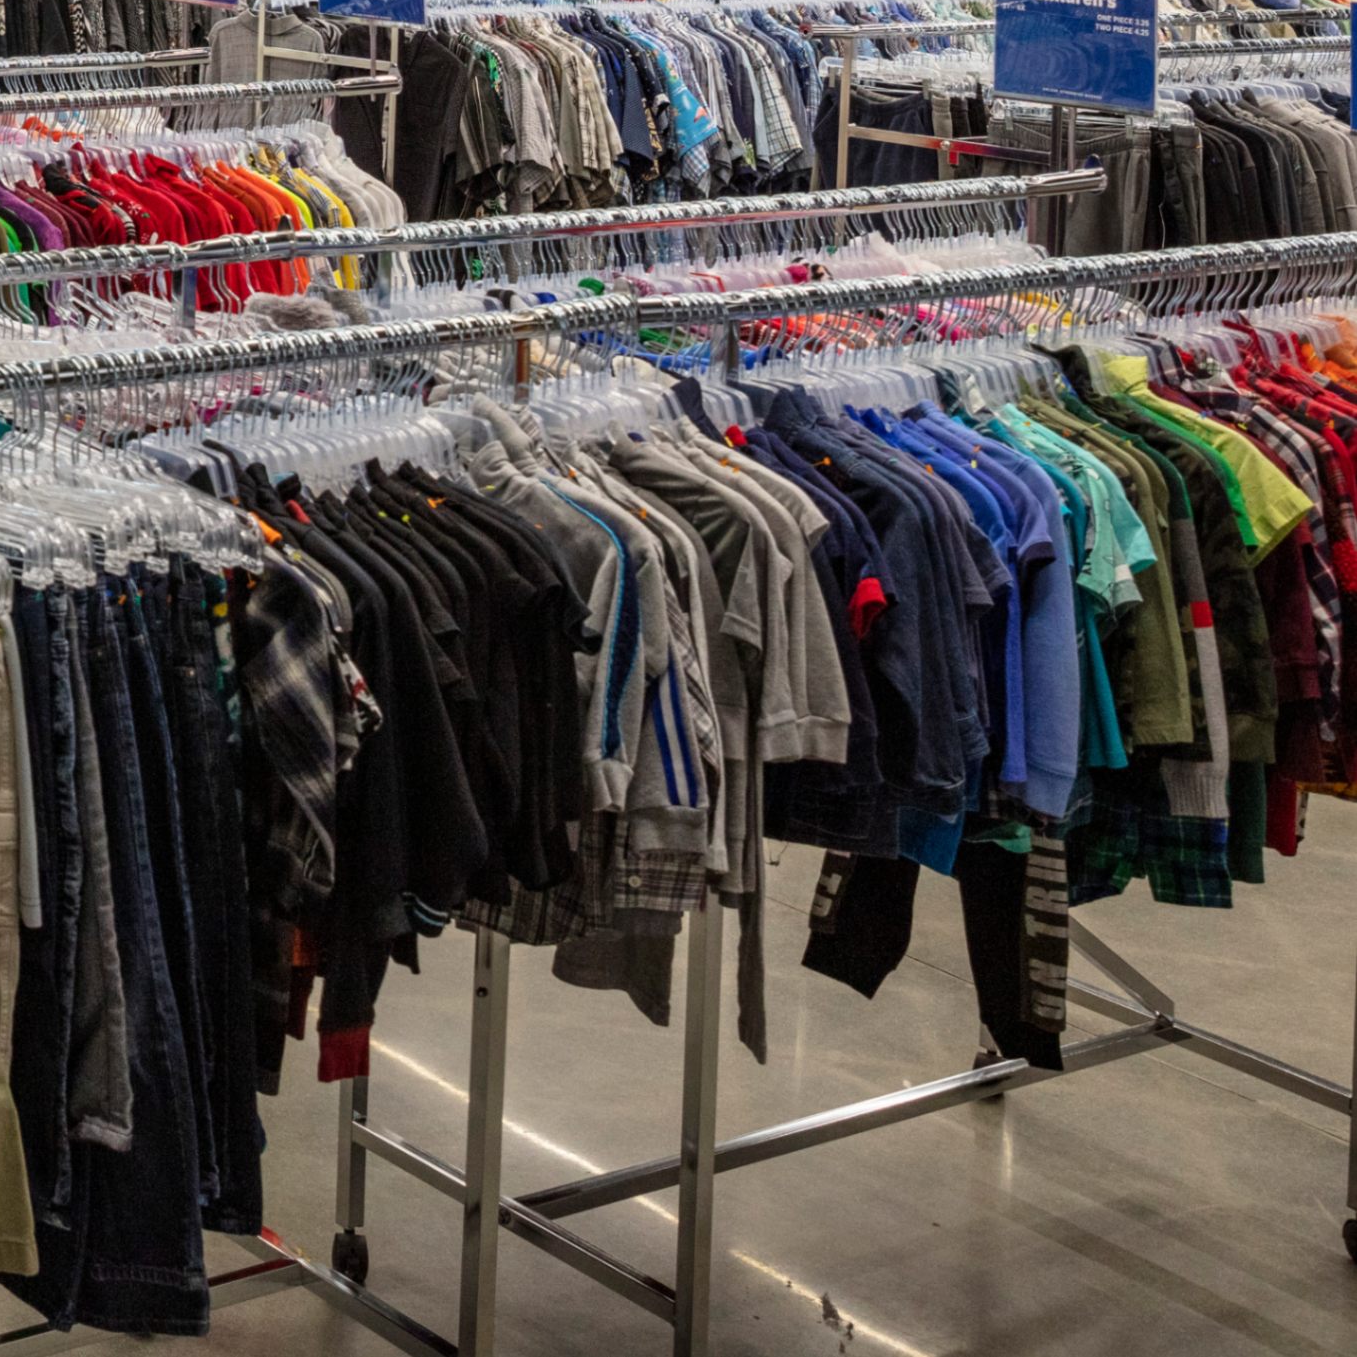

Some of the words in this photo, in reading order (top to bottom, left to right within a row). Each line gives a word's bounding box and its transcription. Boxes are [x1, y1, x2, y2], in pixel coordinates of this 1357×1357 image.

[1097, 14, 1112, 22] ONE
[1113, 16, 1133, 25] PIECE
[1095, 23, 1111, 32] TWO
[1112, 25, 1133, 34] PIECE
[1134, 28, 1150, 36] 4.25
